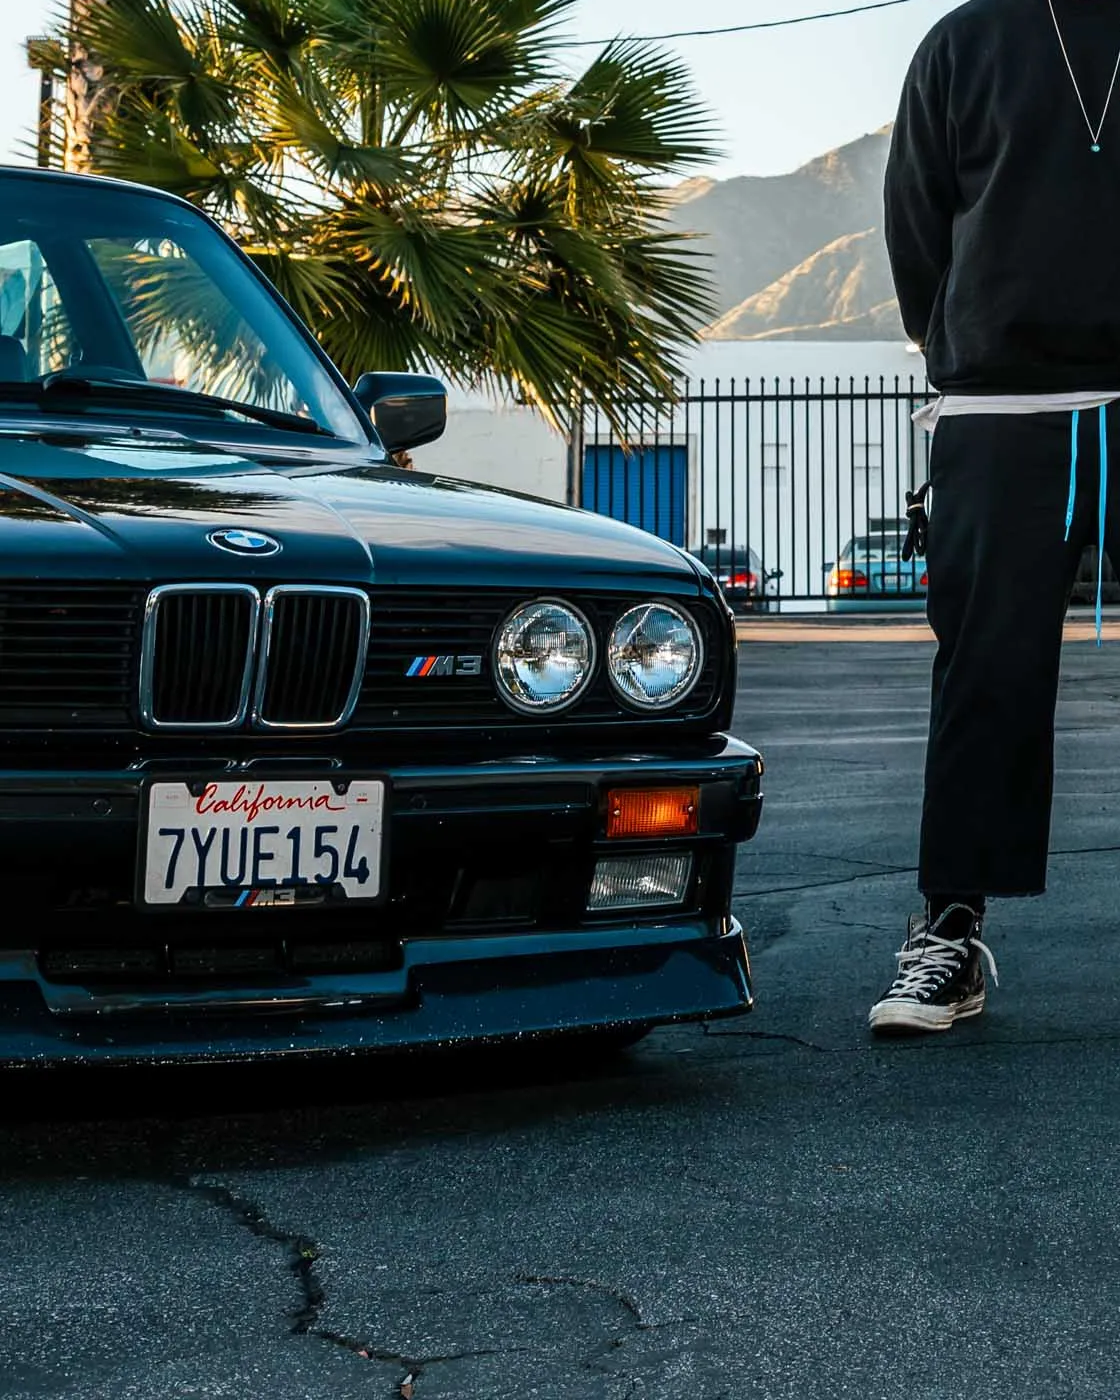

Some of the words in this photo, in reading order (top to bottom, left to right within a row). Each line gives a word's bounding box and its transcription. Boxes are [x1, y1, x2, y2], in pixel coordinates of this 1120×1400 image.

[427, 655, 482, 676] M3
[195, 784, 345, 823] California
[158, 825, 370, 889] 7YUE154
[251, 889, 296, 907] M3
